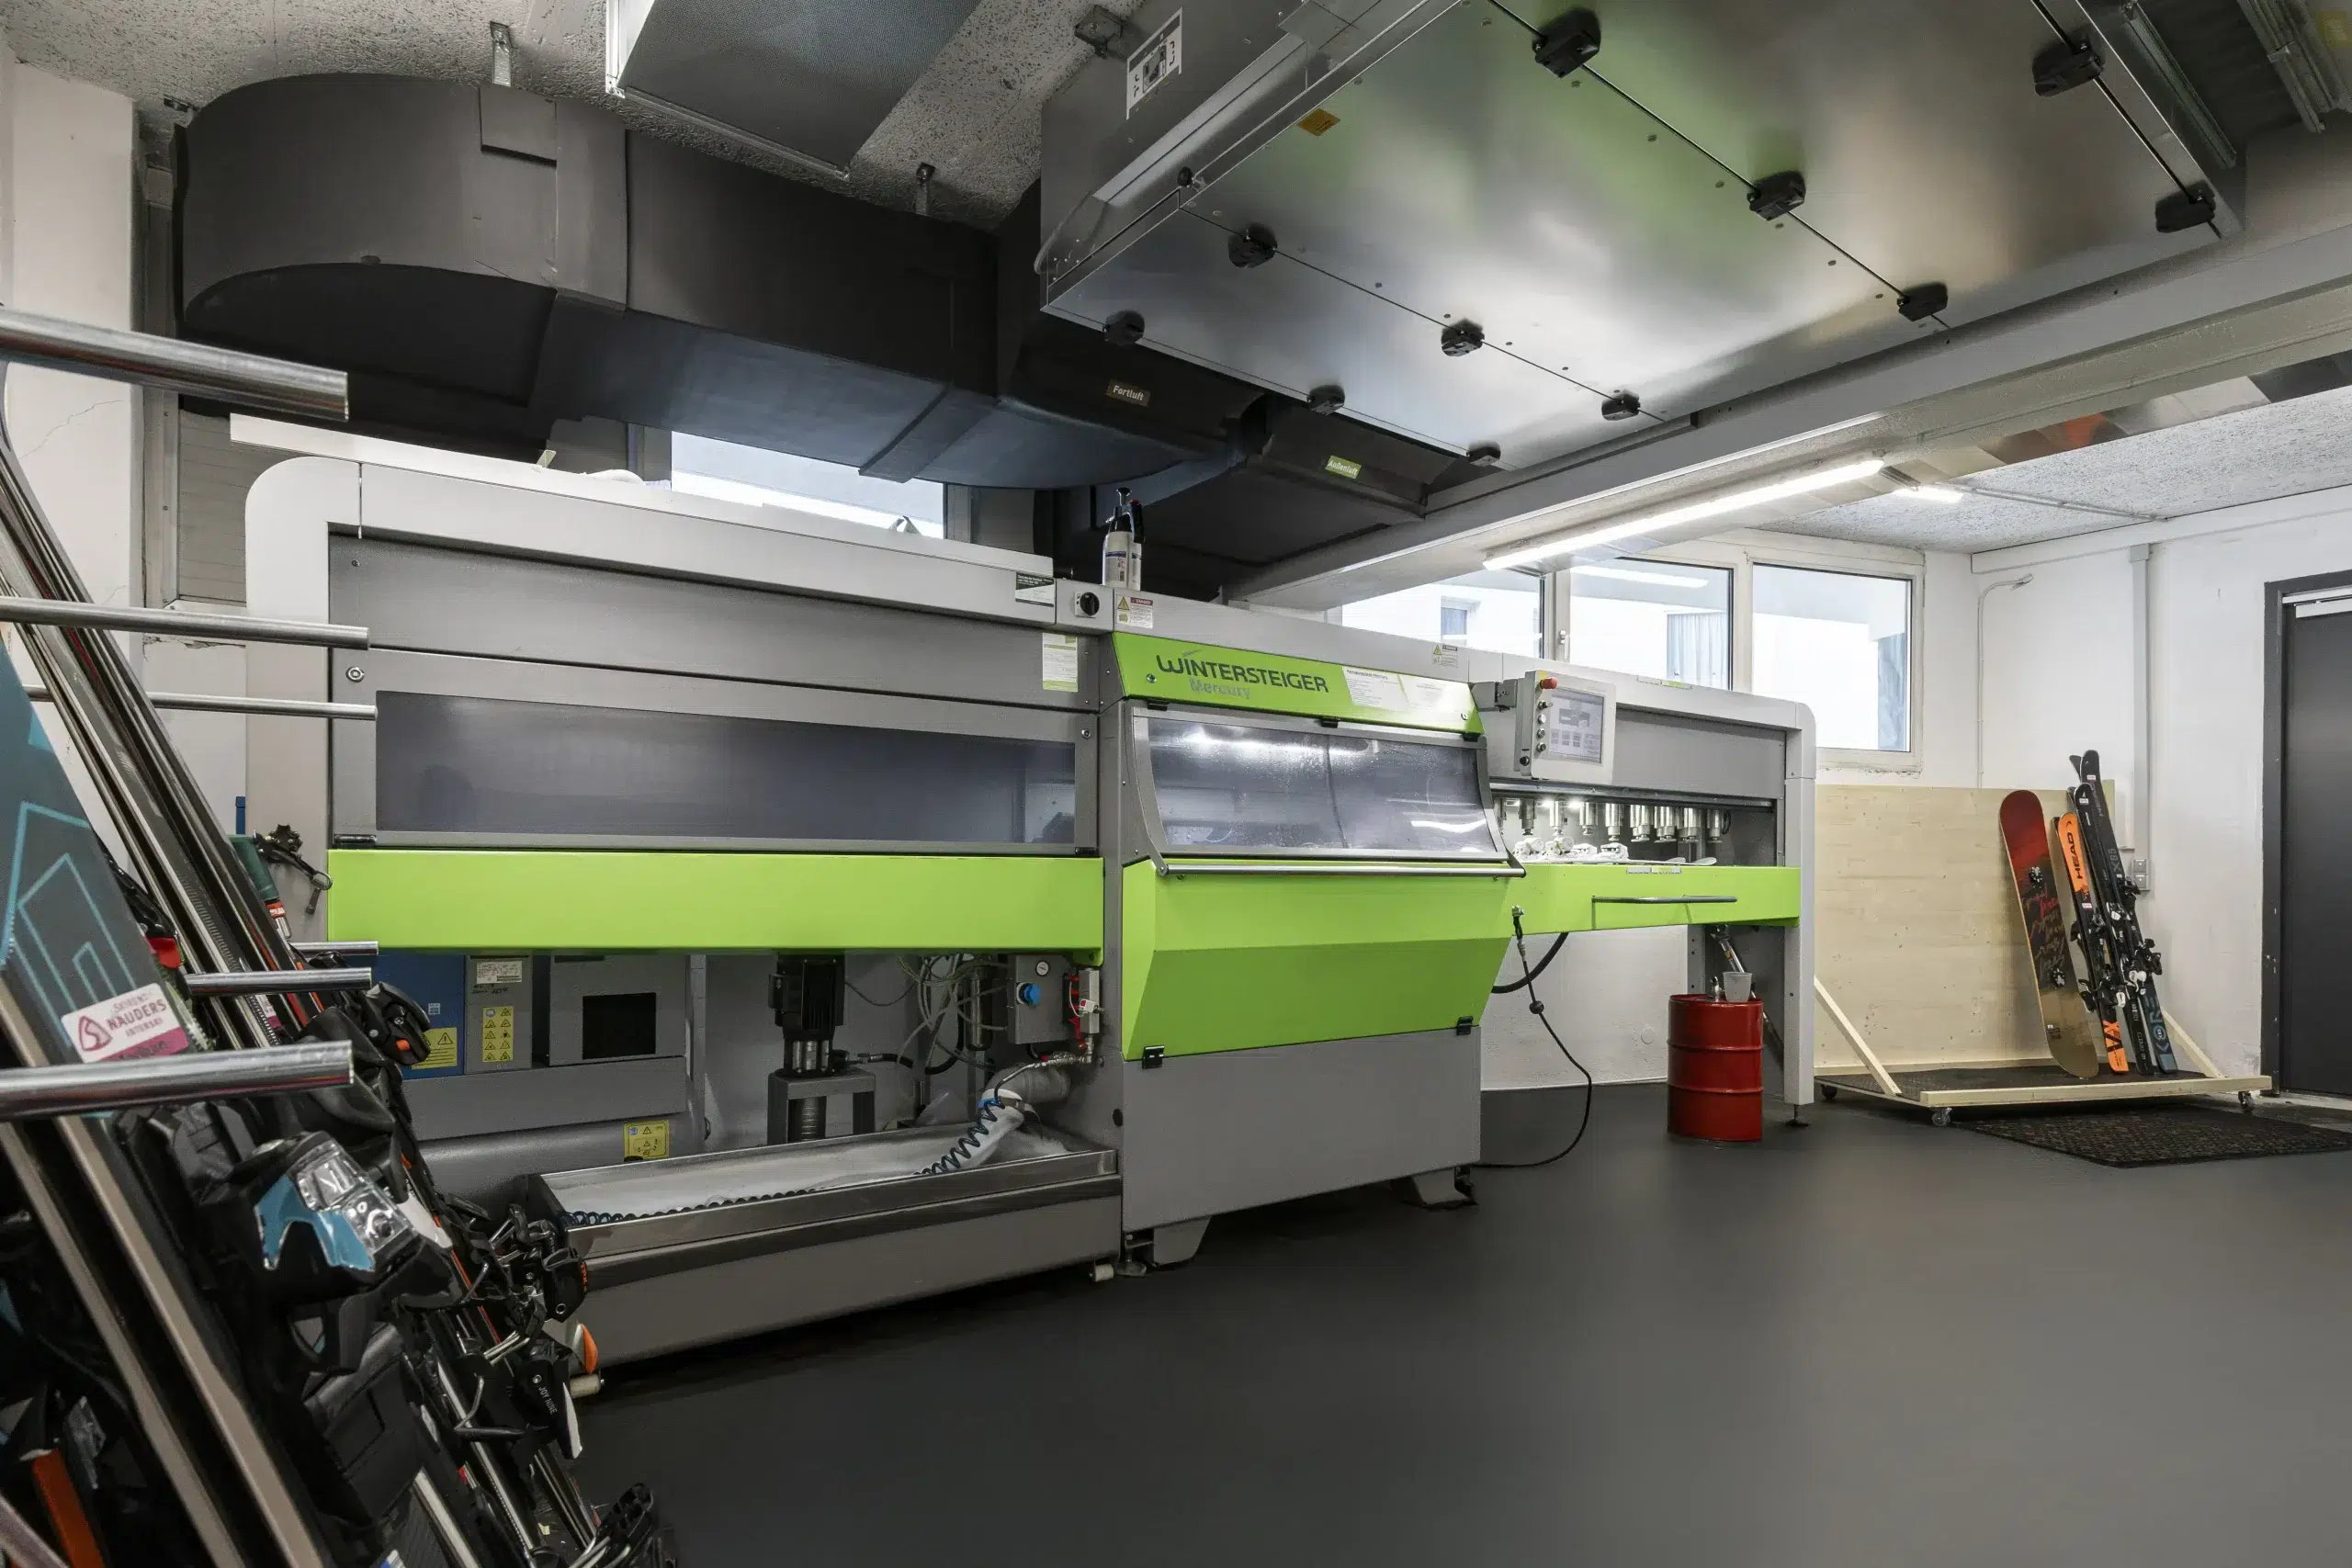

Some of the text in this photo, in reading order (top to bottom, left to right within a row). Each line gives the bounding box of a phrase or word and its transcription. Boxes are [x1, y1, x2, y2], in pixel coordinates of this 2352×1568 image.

[1113, 385, 1145, 402] Fortluft
[1156, 654, 1329, 694] WINTERSTEIGER
[1189, 678, 1250, 700] Mercury
[2067, 831, 2084, 879] HEAD
[107, 999, 168, 1031] NAUDERS
[538, 1386, 558, 1415] JOY NINE
